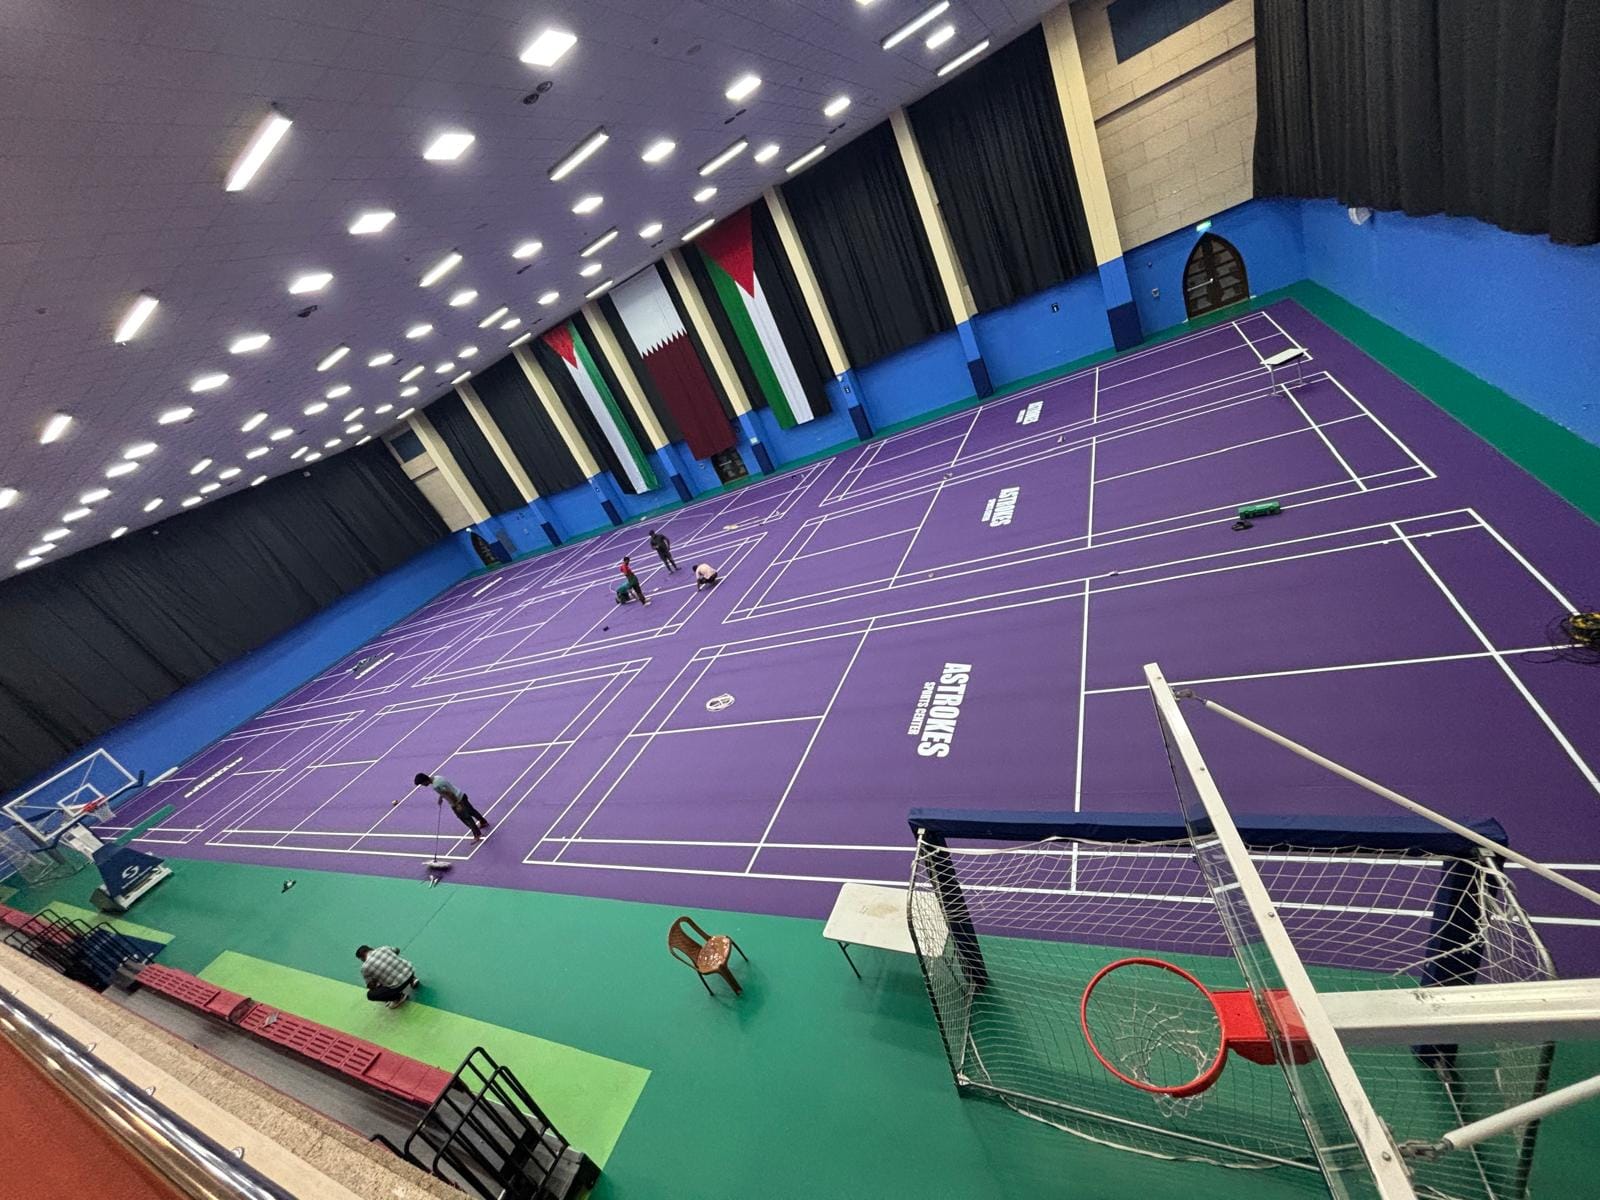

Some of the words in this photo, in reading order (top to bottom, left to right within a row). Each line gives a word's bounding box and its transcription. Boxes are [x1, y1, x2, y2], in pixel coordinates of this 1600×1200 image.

[917, 681, 936, 708] SPORTS
[907, 708, 927, 735] CENTER
[917, 662, 973, 758] ASTROKES
